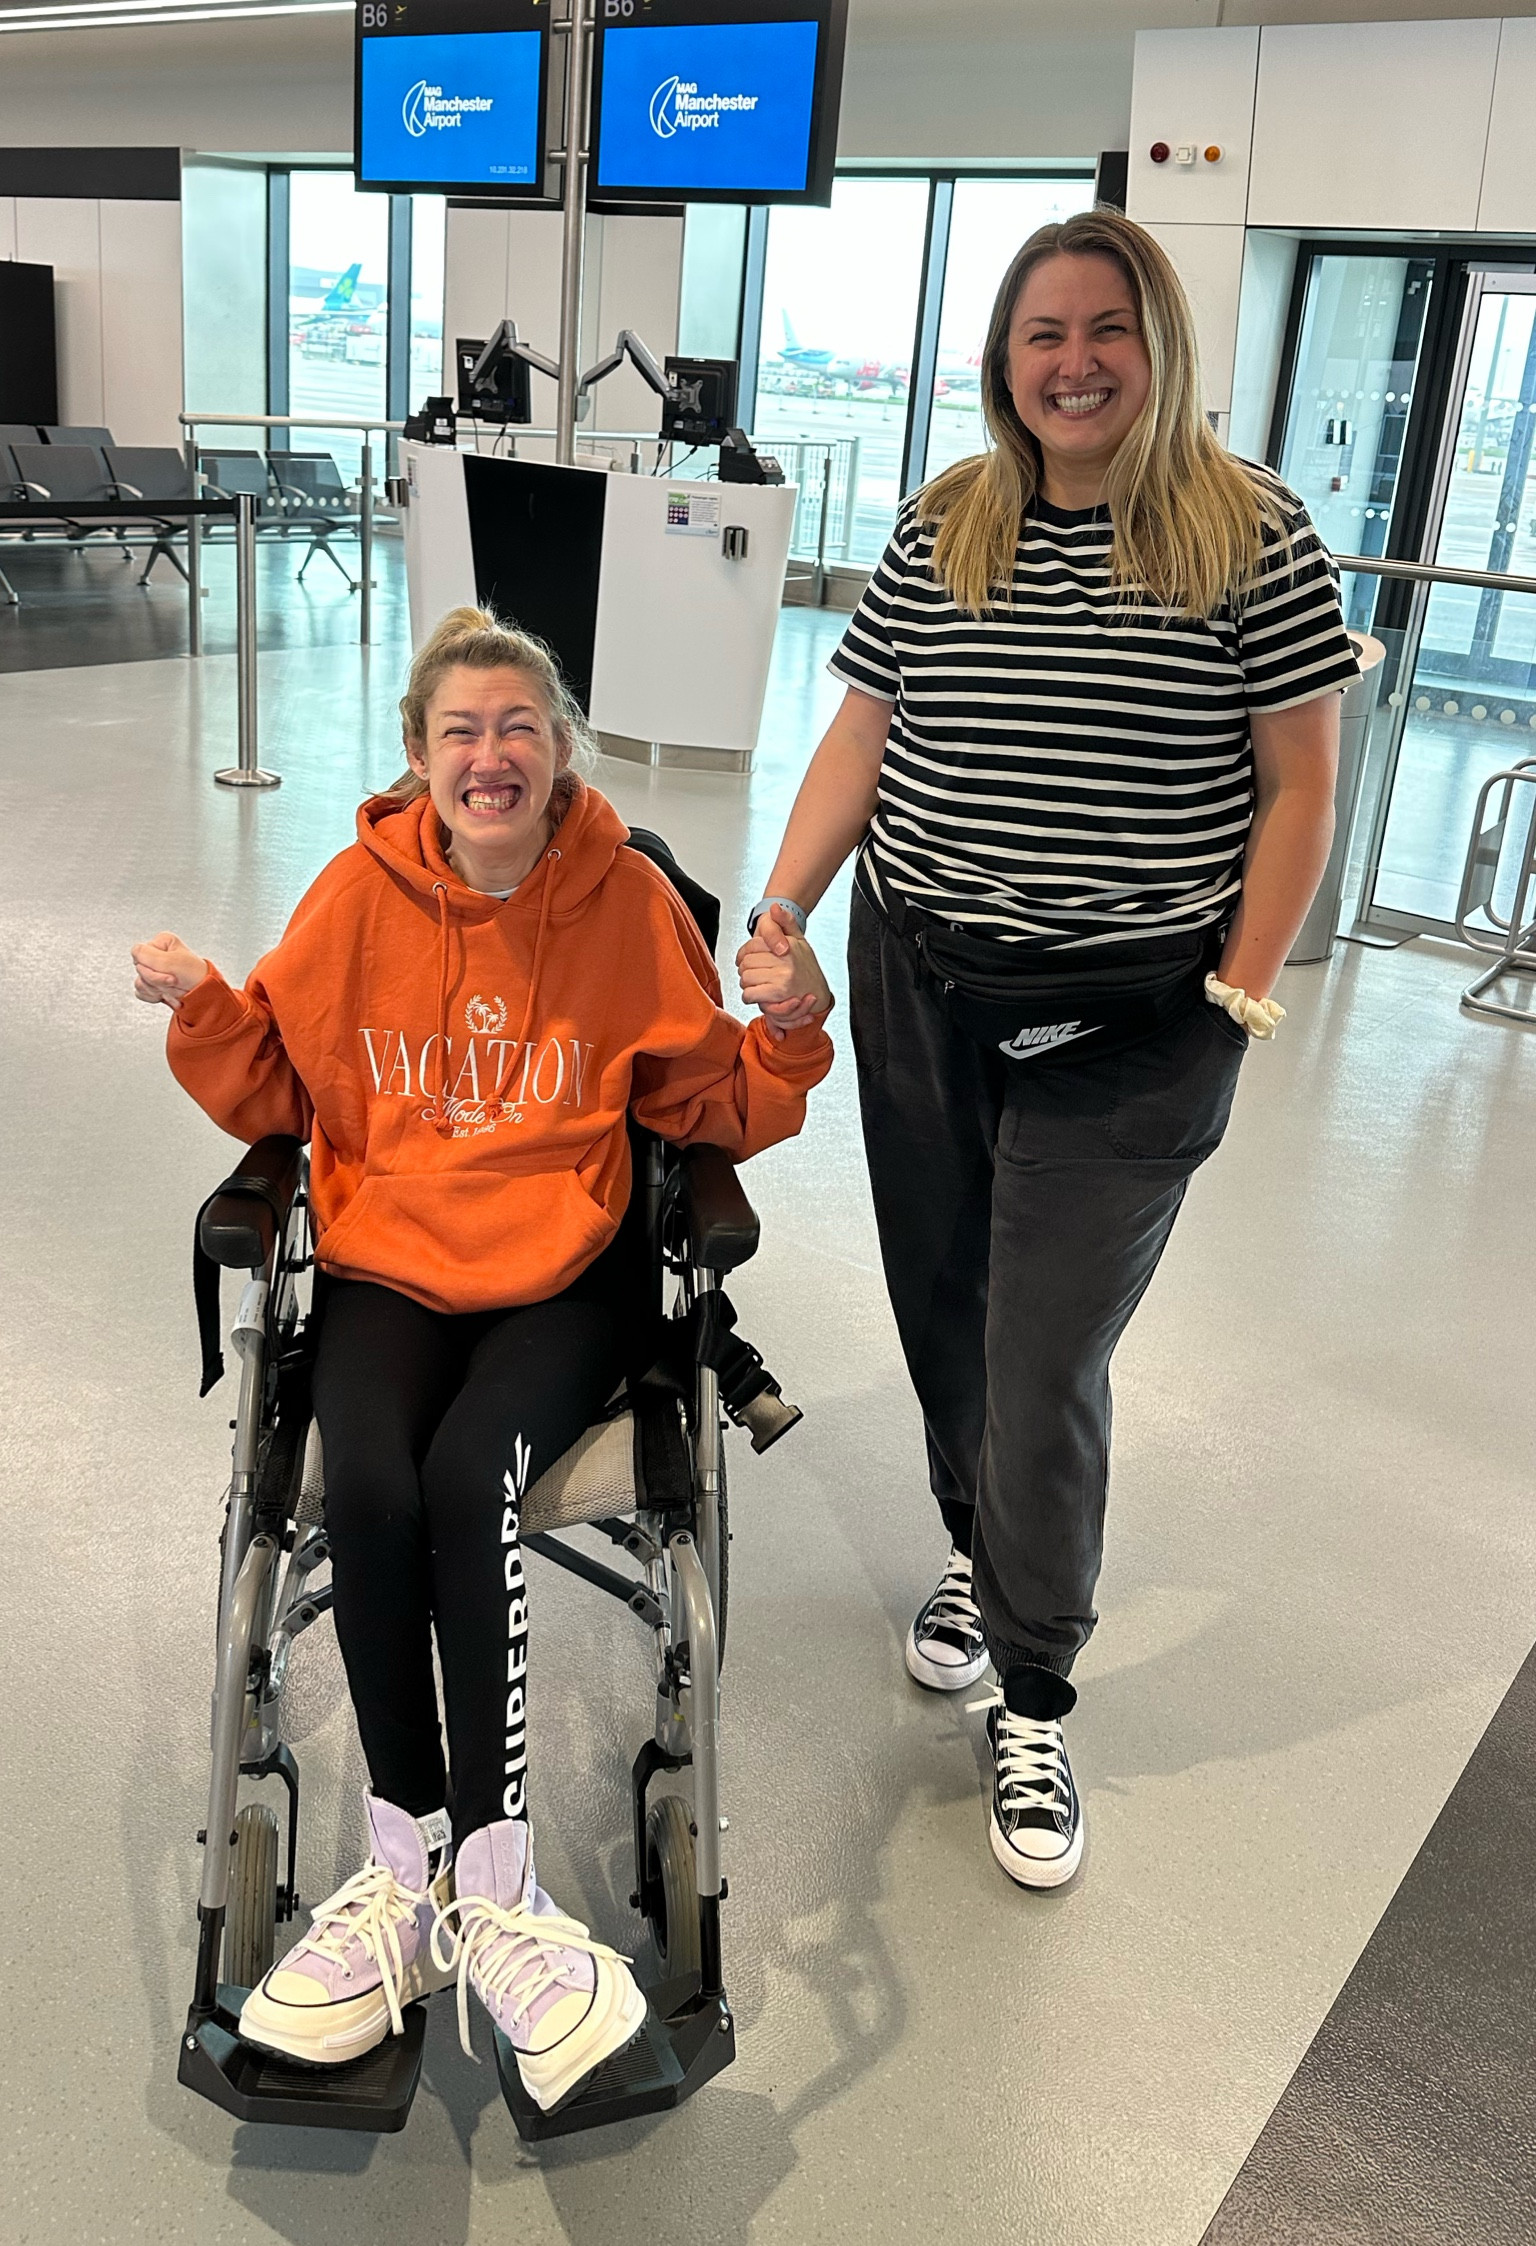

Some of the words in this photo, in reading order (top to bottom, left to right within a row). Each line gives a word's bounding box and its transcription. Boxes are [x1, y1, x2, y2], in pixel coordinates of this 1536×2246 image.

[362, 3, 388, 28] B6
[604, 0, 634, 17] B6
[424, 86, 442, 97] MAG
[676, 82, 698, 94] MAG
[424, 96, 493, 112] Manchester
[675, 93, 758, 111] Manchester
[423, 112, 461, 131] Airport
[674, 111, 719, 131] Airport
[1012, 1020, 1082, 1047] NIKE
[358, 1028, 595, 1108] VACATION
[421, 1097, 486, 1124] Mode
[451, 1125, 470, 1138] Est.
